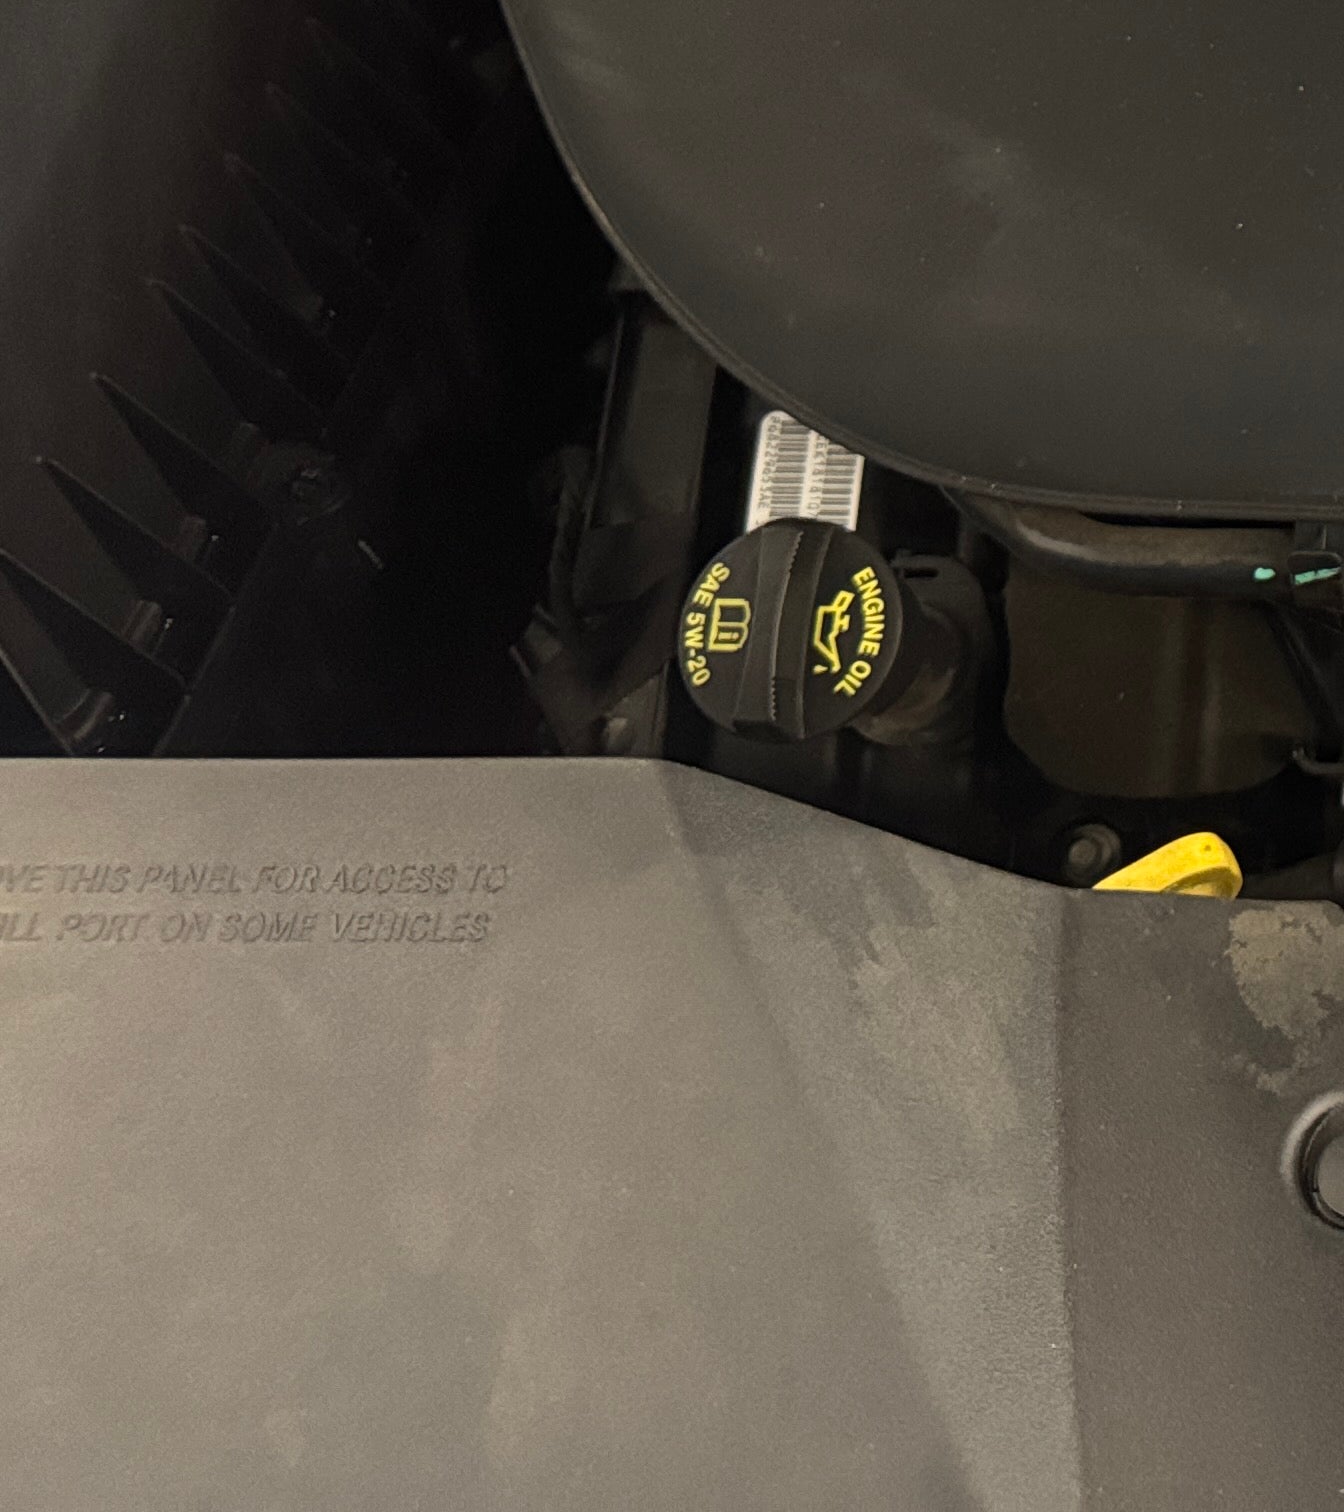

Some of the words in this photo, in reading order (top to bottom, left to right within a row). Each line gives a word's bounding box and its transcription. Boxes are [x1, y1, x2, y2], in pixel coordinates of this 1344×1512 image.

[693, 562, 731, 607] SAE
[852, 566, 886, 656] ENGINE
[684, 612, 711, 685] 5W-20
[833, 660, 872, 696] OIL
[56, 864, 131, 893] THIS
[137, 863, 241, 894] PANEL
[252, 862, 320, 894] FOR
[324, 863, 457, 894] ACCESS
[466, 863, 507, 895] TO
[56, 912, 150, 943] PORT
[160, 911, 210, 943] ON
[217, 910, 318, 943] SOME
[331, 910, 491, 943] VEHICLES
